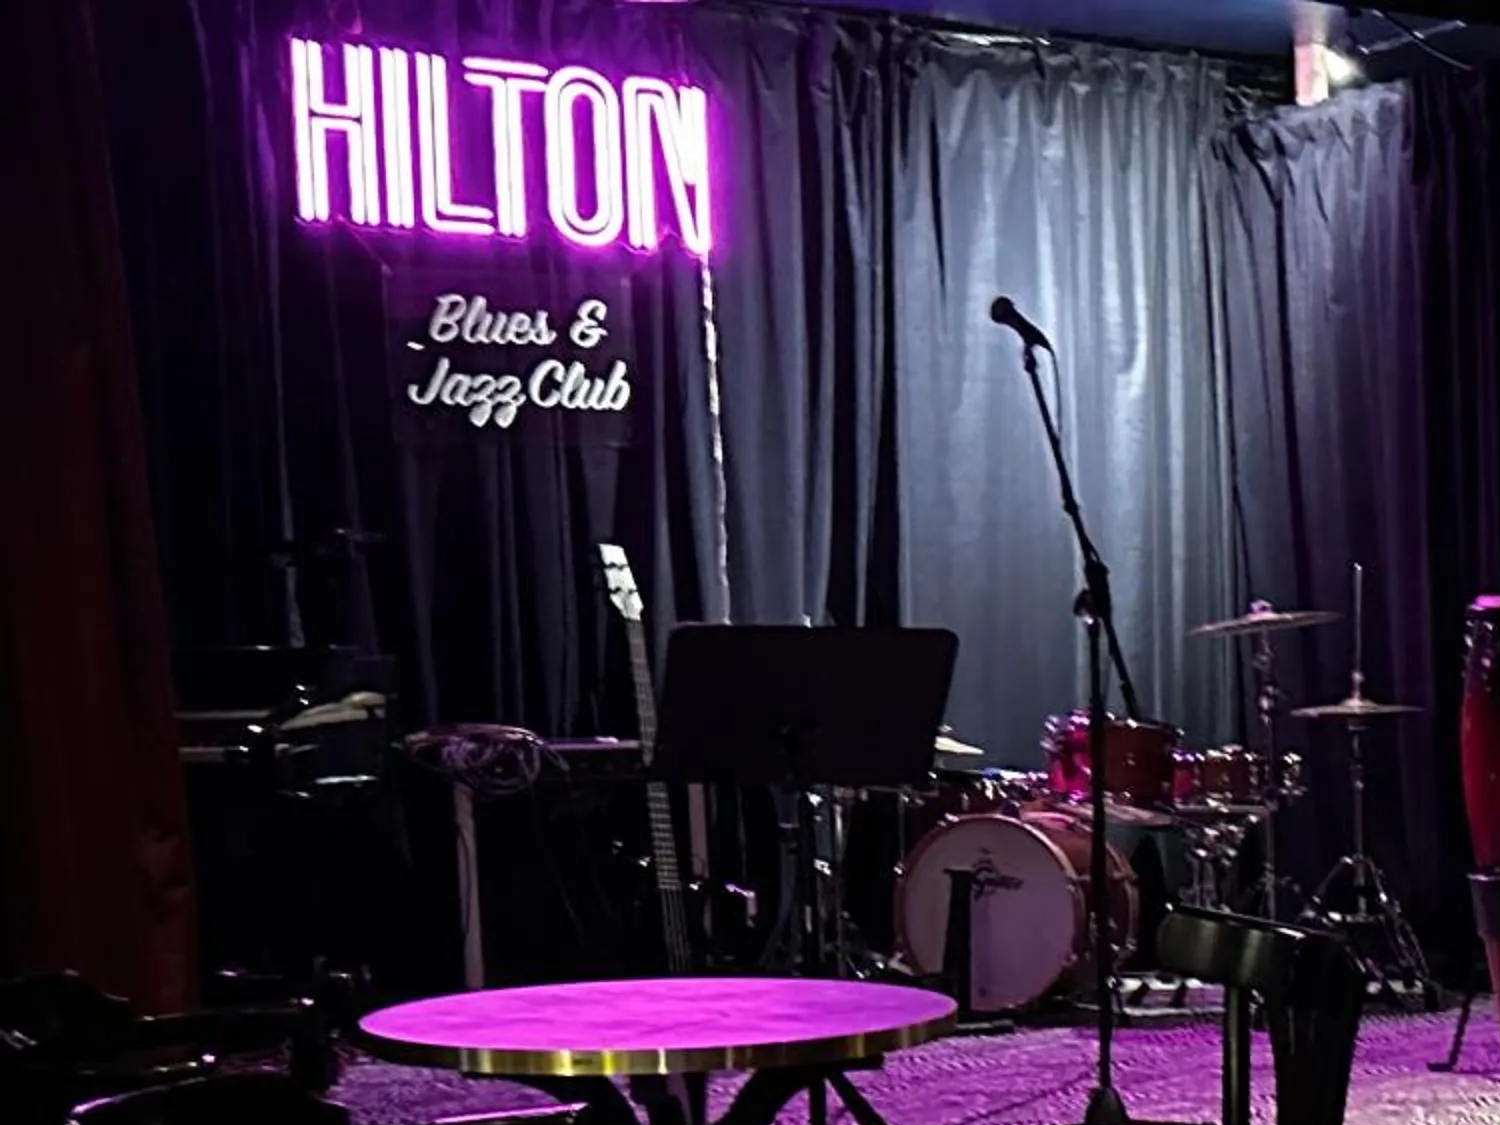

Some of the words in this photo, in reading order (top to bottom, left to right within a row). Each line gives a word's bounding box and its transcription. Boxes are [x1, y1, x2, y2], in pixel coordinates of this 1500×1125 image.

[291, 36, 711, 256] HILTON
[429, 294, 557, 347] Blues
[569, 299, 609, 349] &
[407, 357, 527, 429] Jazz
[527, 359, 631, 411] Club
